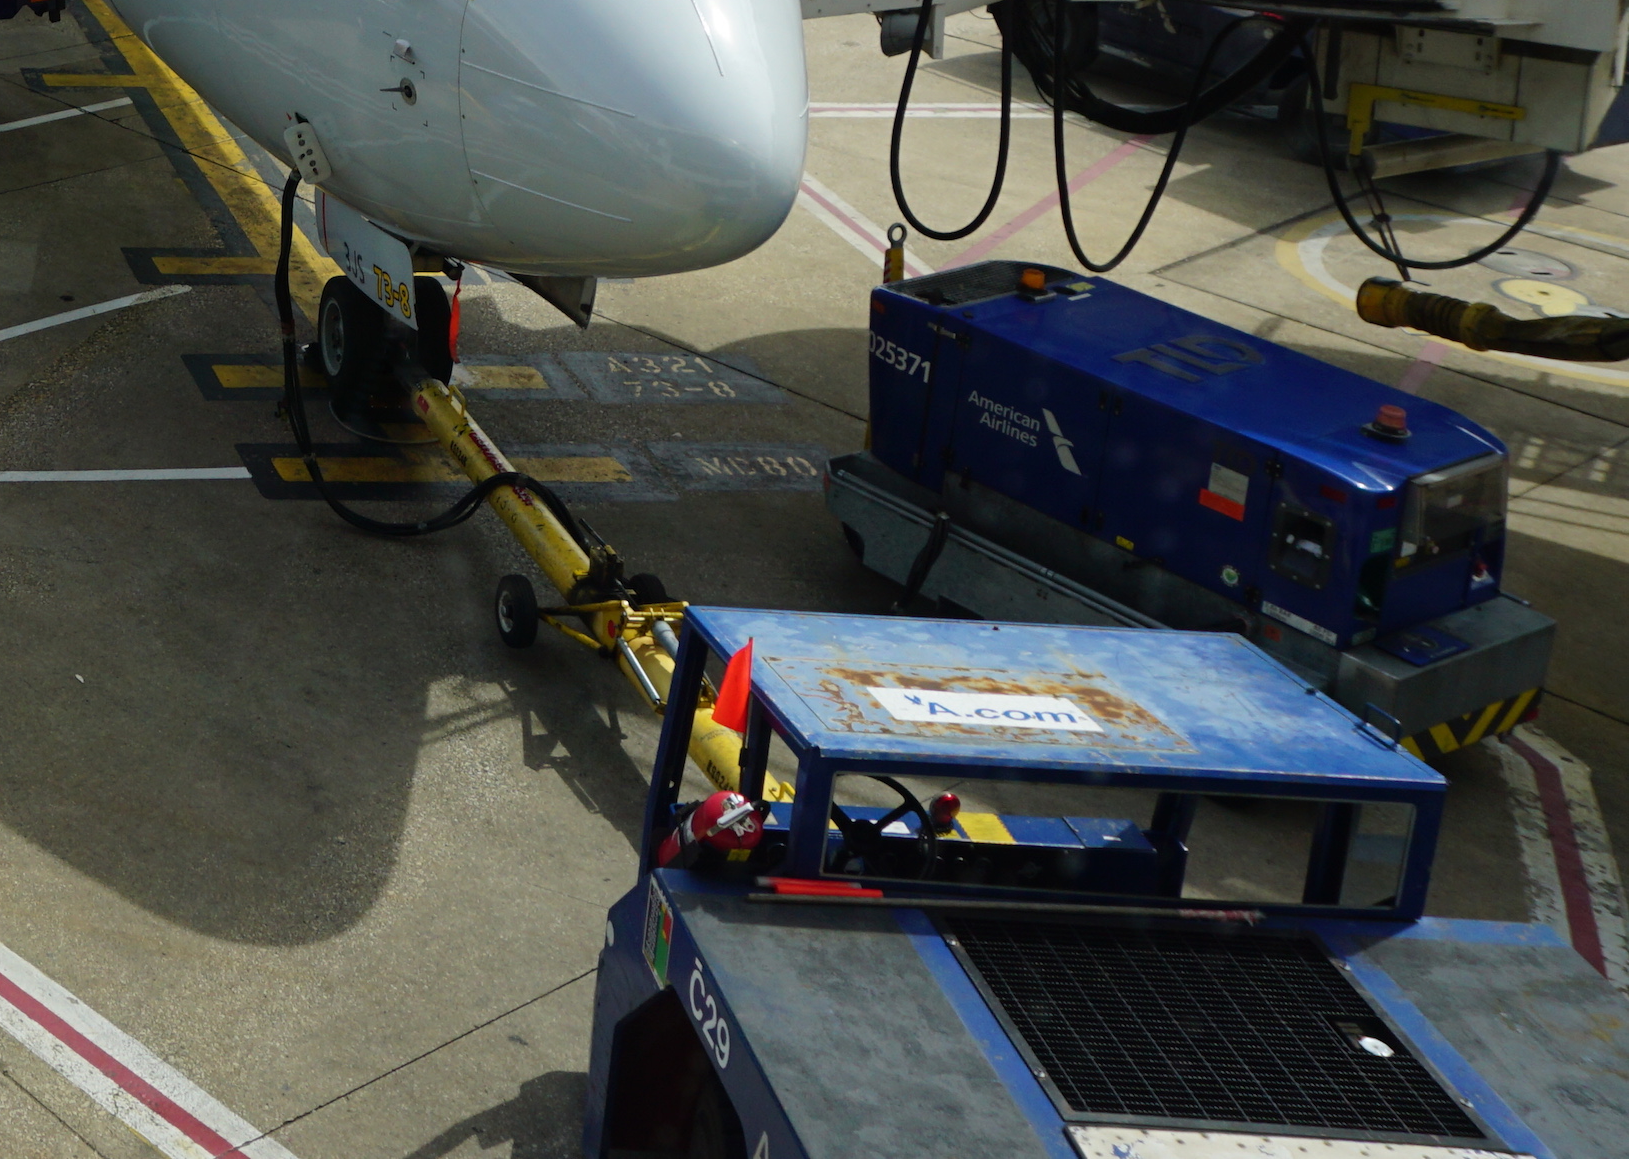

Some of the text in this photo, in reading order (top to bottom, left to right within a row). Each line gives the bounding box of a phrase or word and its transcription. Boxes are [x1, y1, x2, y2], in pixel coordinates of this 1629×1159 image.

[373, 263, 412, 319] 73-8
[967, 389, 1042, 433] American
[979, 411, 1038, 448] Airlines
[689, 967, 731, 1070] C29
